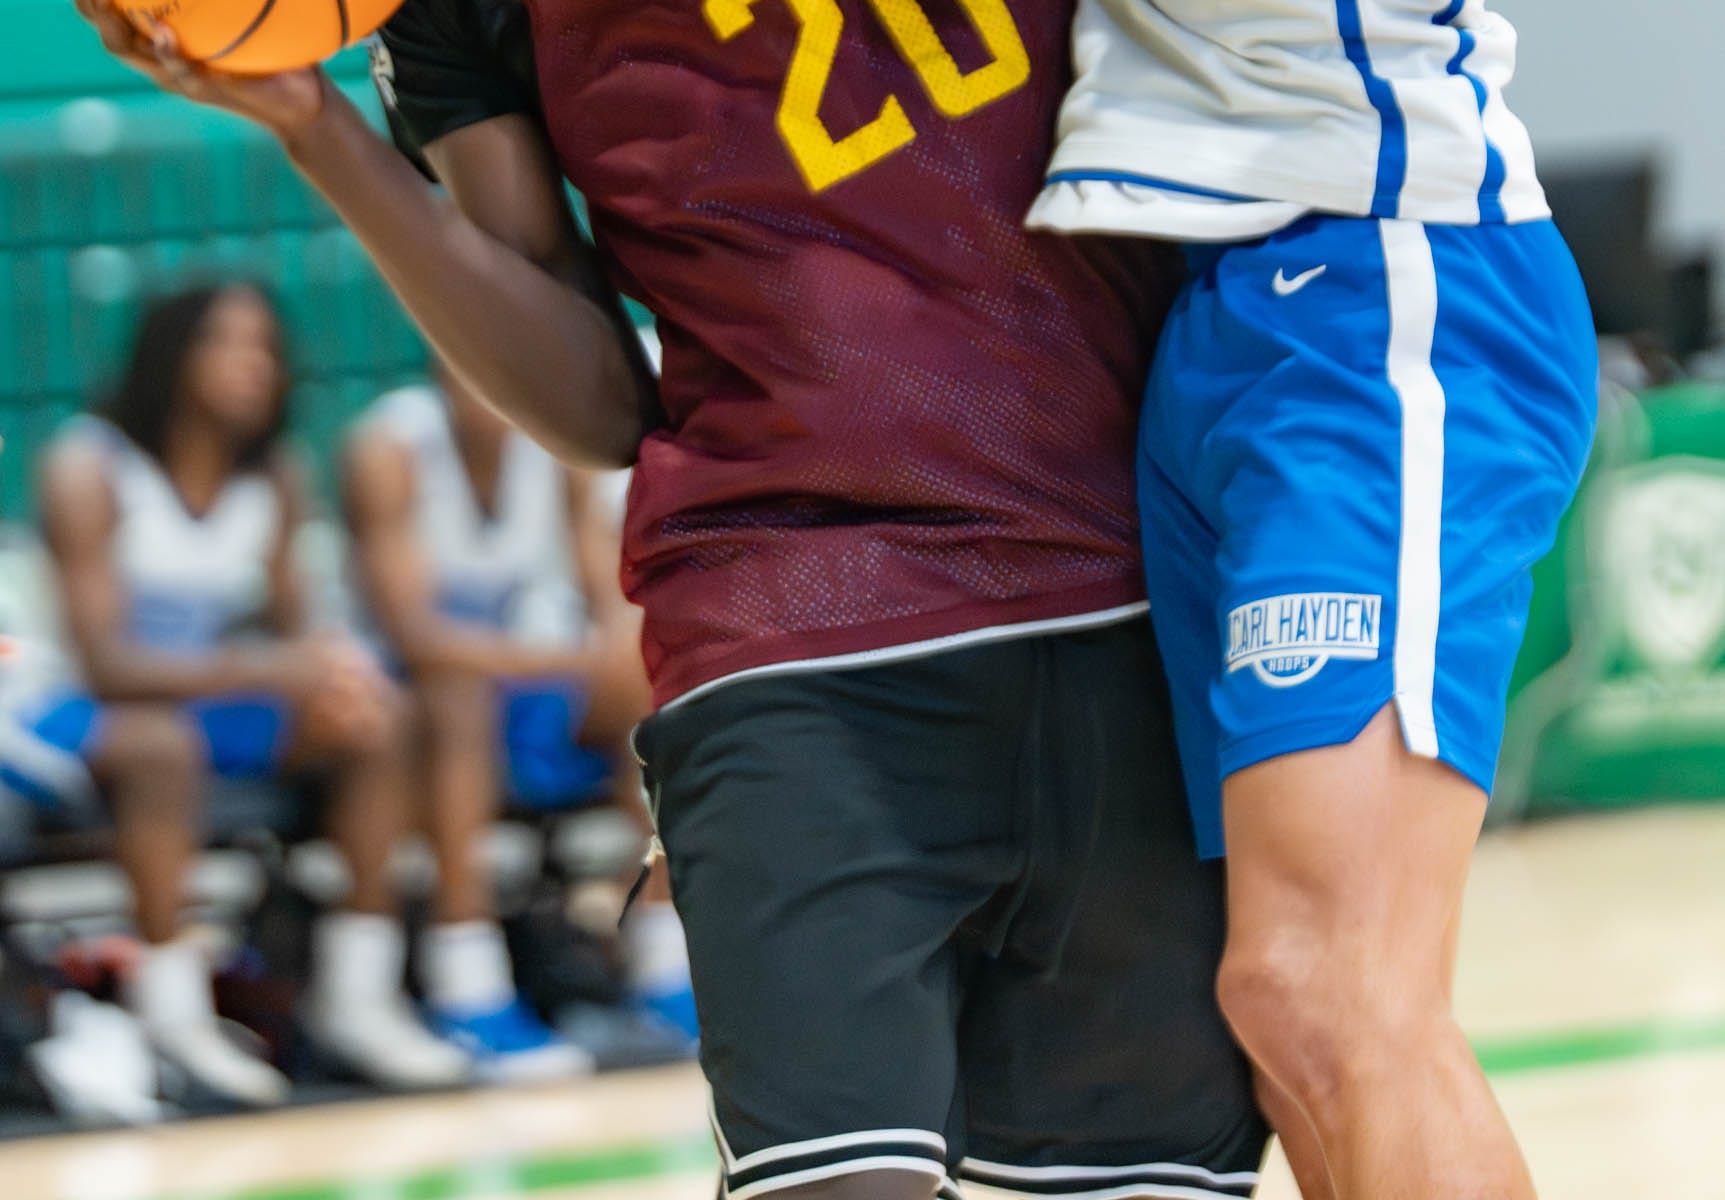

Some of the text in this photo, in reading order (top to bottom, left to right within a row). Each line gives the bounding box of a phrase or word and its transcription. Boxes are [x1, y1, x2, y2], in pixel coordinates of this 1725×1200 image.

[1230, 598, 1378, 656] CARL HAYDEN
[1268, 656, 1310, 673] HOOPS
